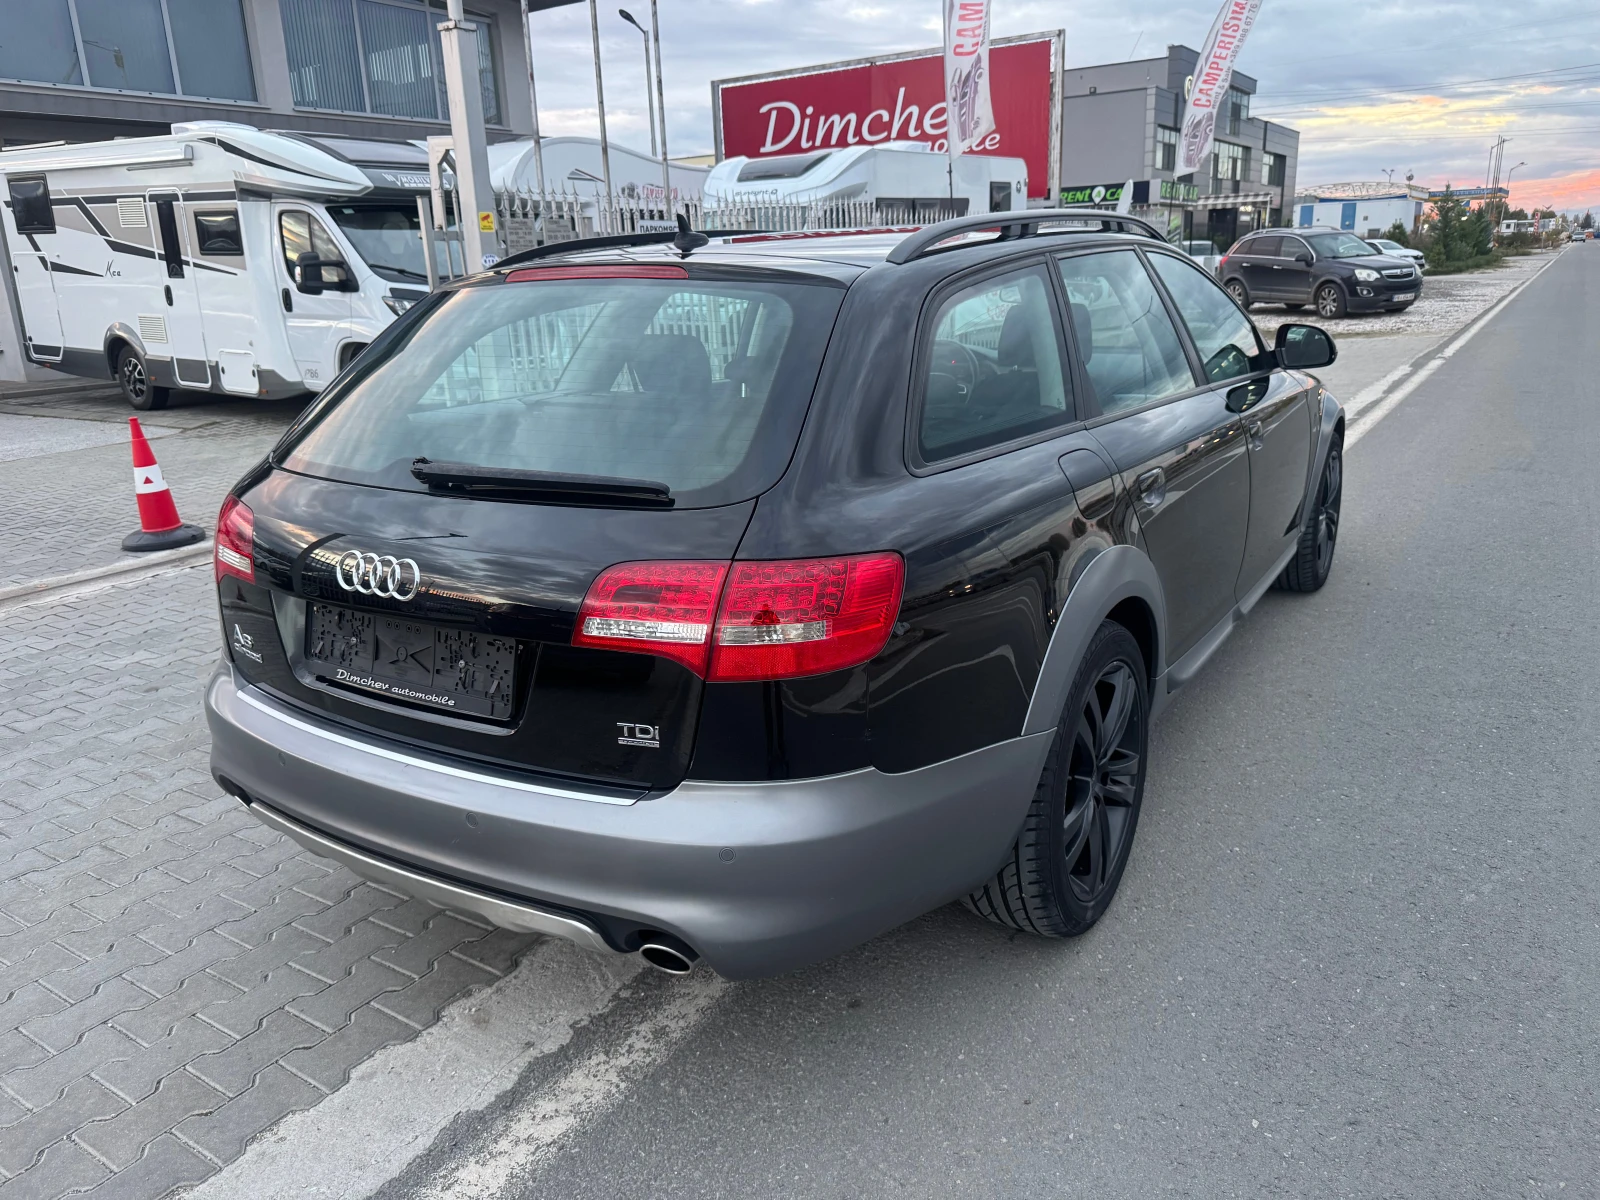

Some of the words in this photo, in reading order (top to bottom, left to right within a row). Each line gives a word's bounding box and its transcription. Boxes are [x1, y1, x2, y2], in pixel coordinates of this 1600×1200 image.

[1244, 15, 1253, 26] 67
[759, 87, 947, 153] Dimche
[1106, 188, 1122, 200] CA
[640, 225, 679, 233] ПАРКОМЯС
[336, 669, 390, 690] Dimchev
[391, 686, 455, 707] automobile
